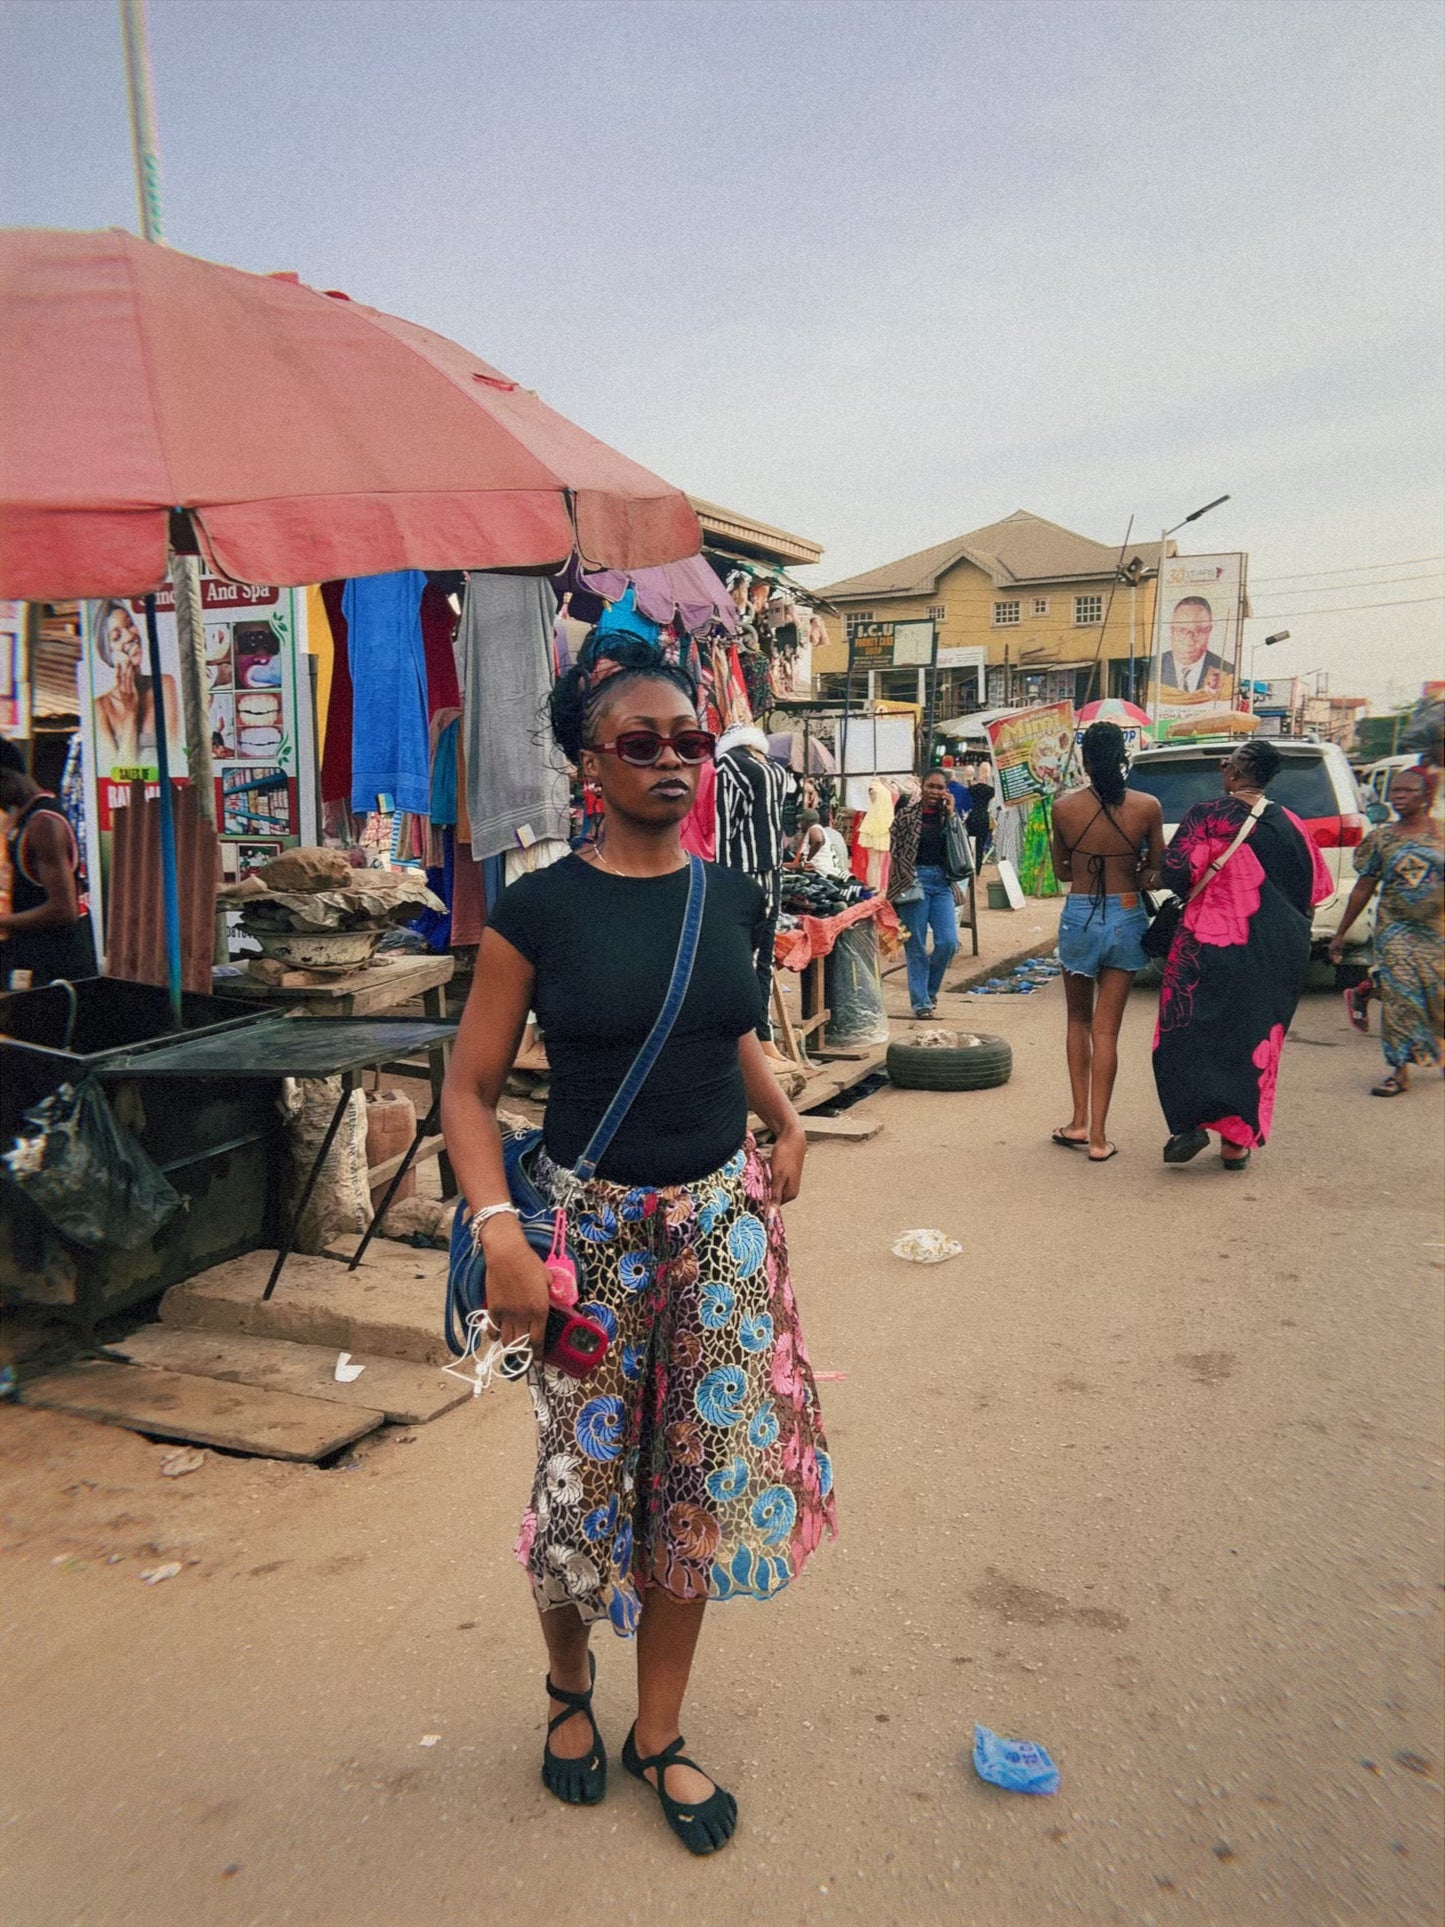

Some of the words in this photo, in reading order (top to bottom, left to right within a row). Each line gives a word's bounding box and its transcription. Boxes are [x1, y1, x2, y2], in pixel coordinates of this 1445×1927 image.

[207, 582, 238, 601] And
[242, 584, 270, 602] Spa
[857, 623, 894, 638] I.C.U
